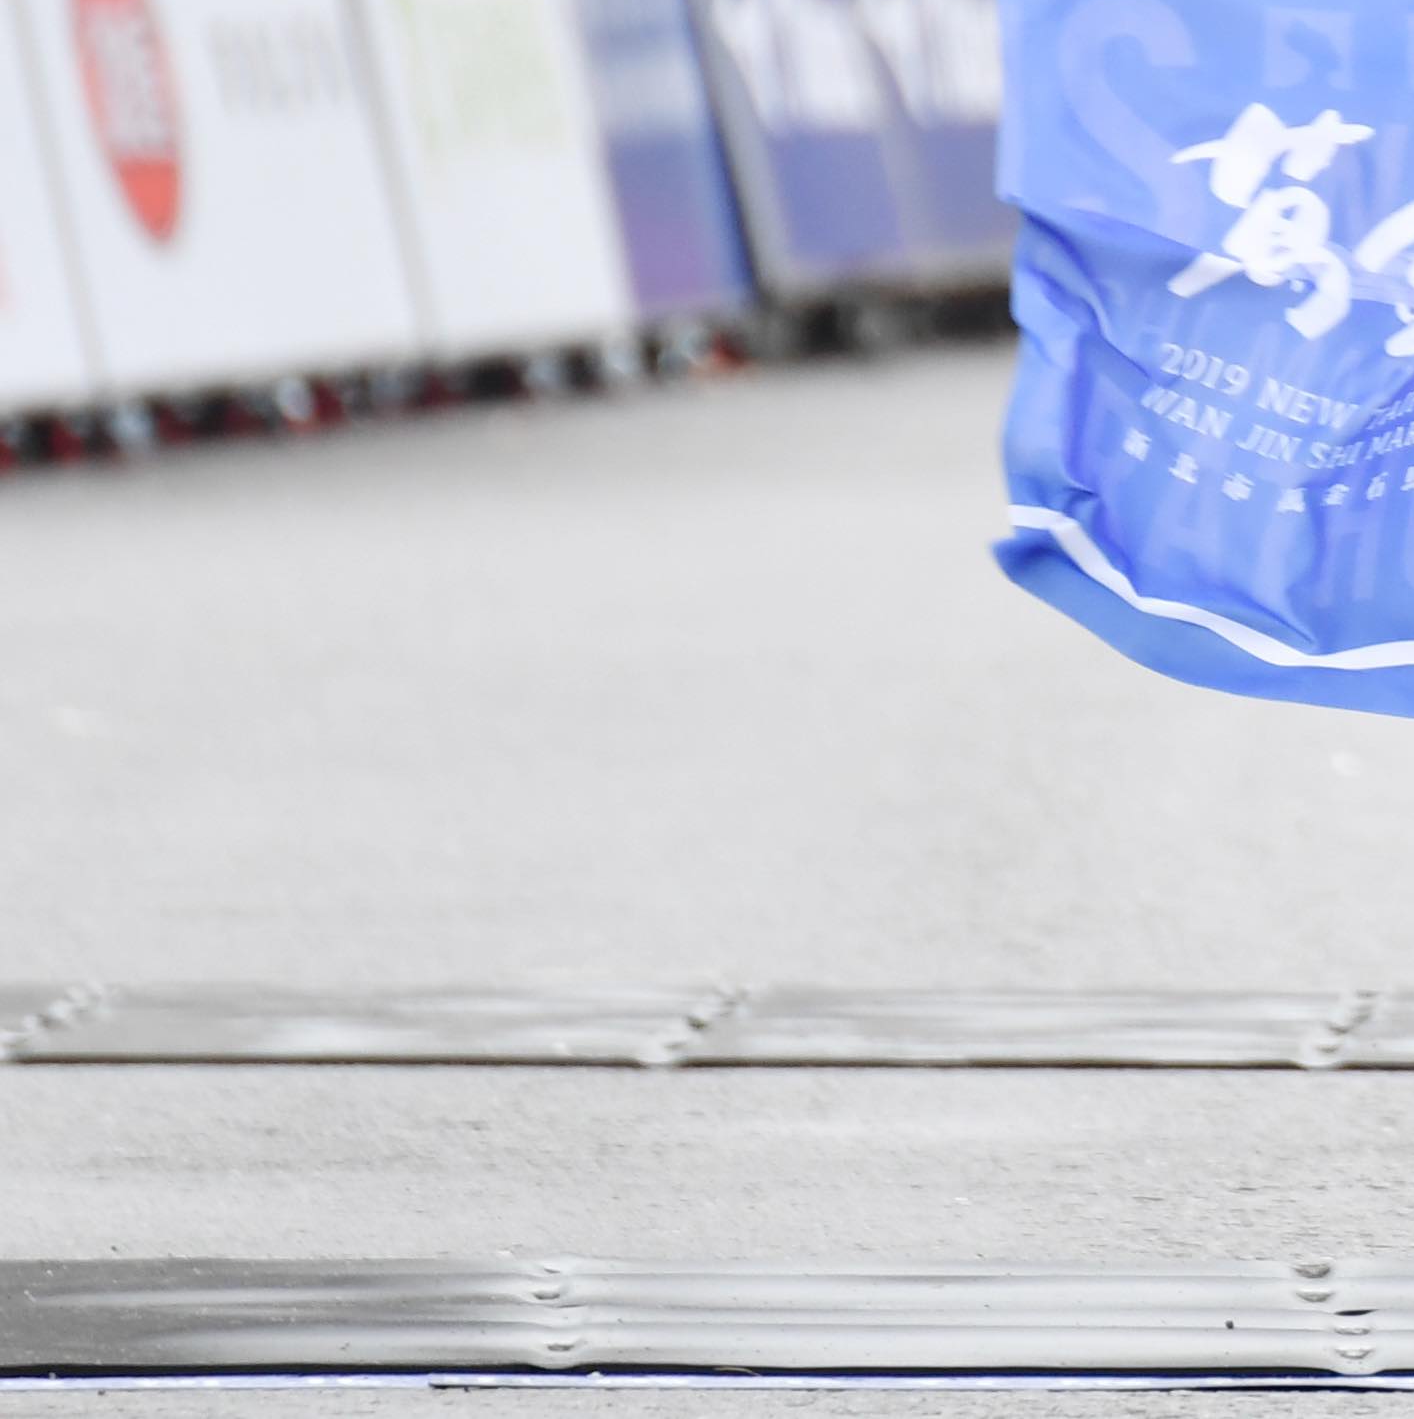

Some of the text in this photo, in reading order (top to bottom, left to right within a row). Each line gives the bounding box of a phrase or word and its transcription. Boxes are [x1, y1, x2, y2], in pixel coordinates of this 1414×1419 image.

[1140, 384, 1234, 440] WAN
[1235, 423, 1302, 464] JIN
[1305, 441, 1364, 471] SHI
[1160, 342, 1250, 396] 2019
[1257, 377, 1361, 429] NEW
